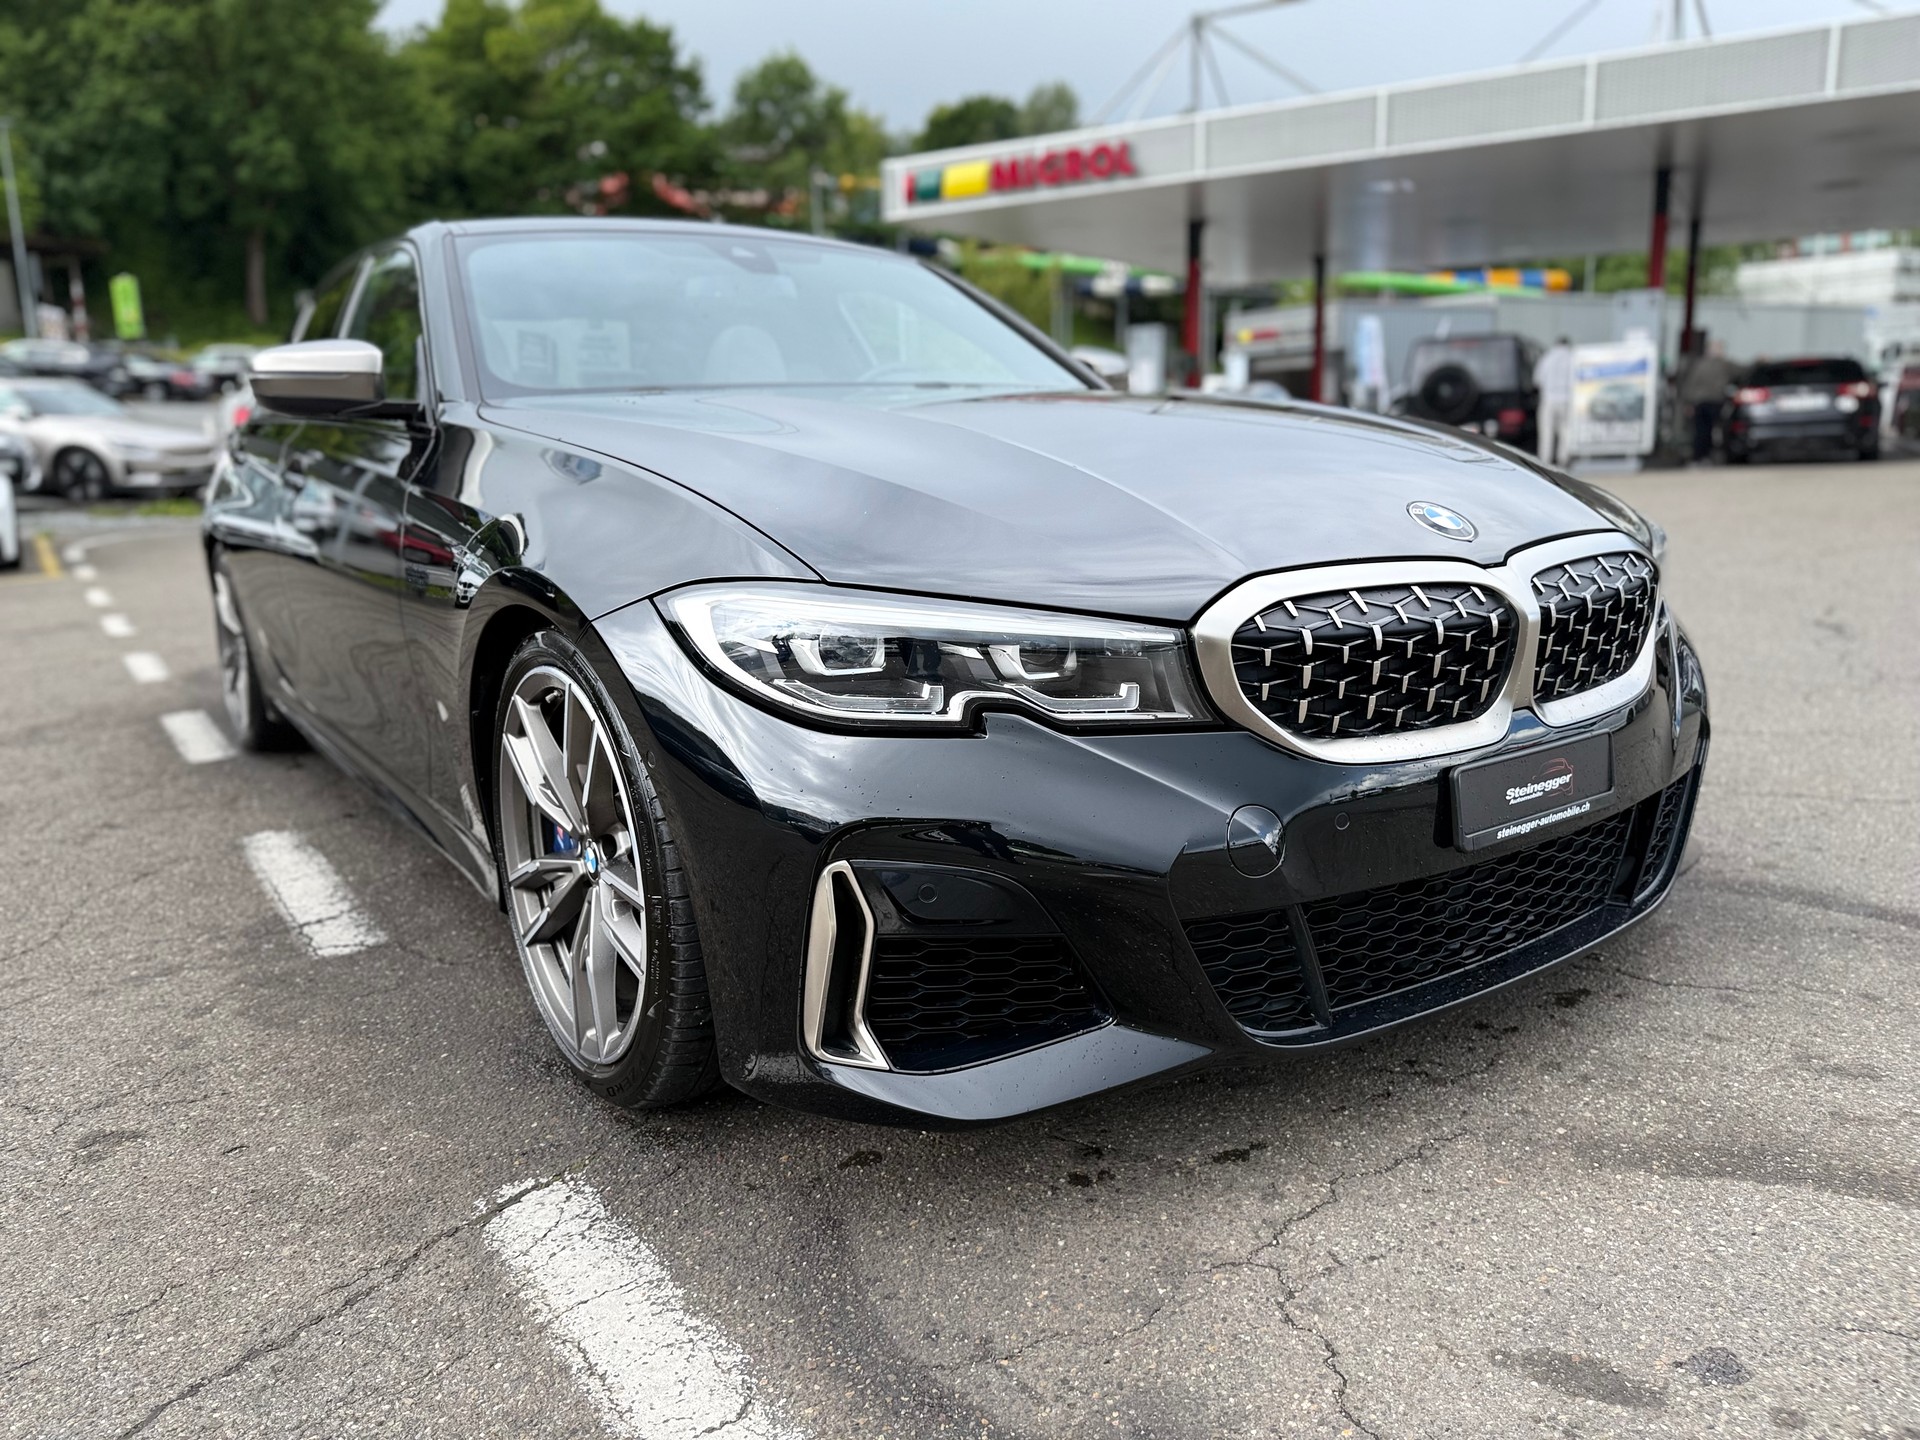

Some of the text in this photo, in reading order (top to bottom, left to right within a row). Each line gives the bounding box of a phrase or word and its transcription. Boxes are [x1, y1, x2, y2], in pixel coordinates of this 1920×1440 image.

[990, 140, 1137, 192] MIGROL
[1505, 773, 1572, 800] Steinegger
[1509, 791, 1543, 805] Automobile
[1496, 801, 1591, 839] steinegger-automobile.ch
